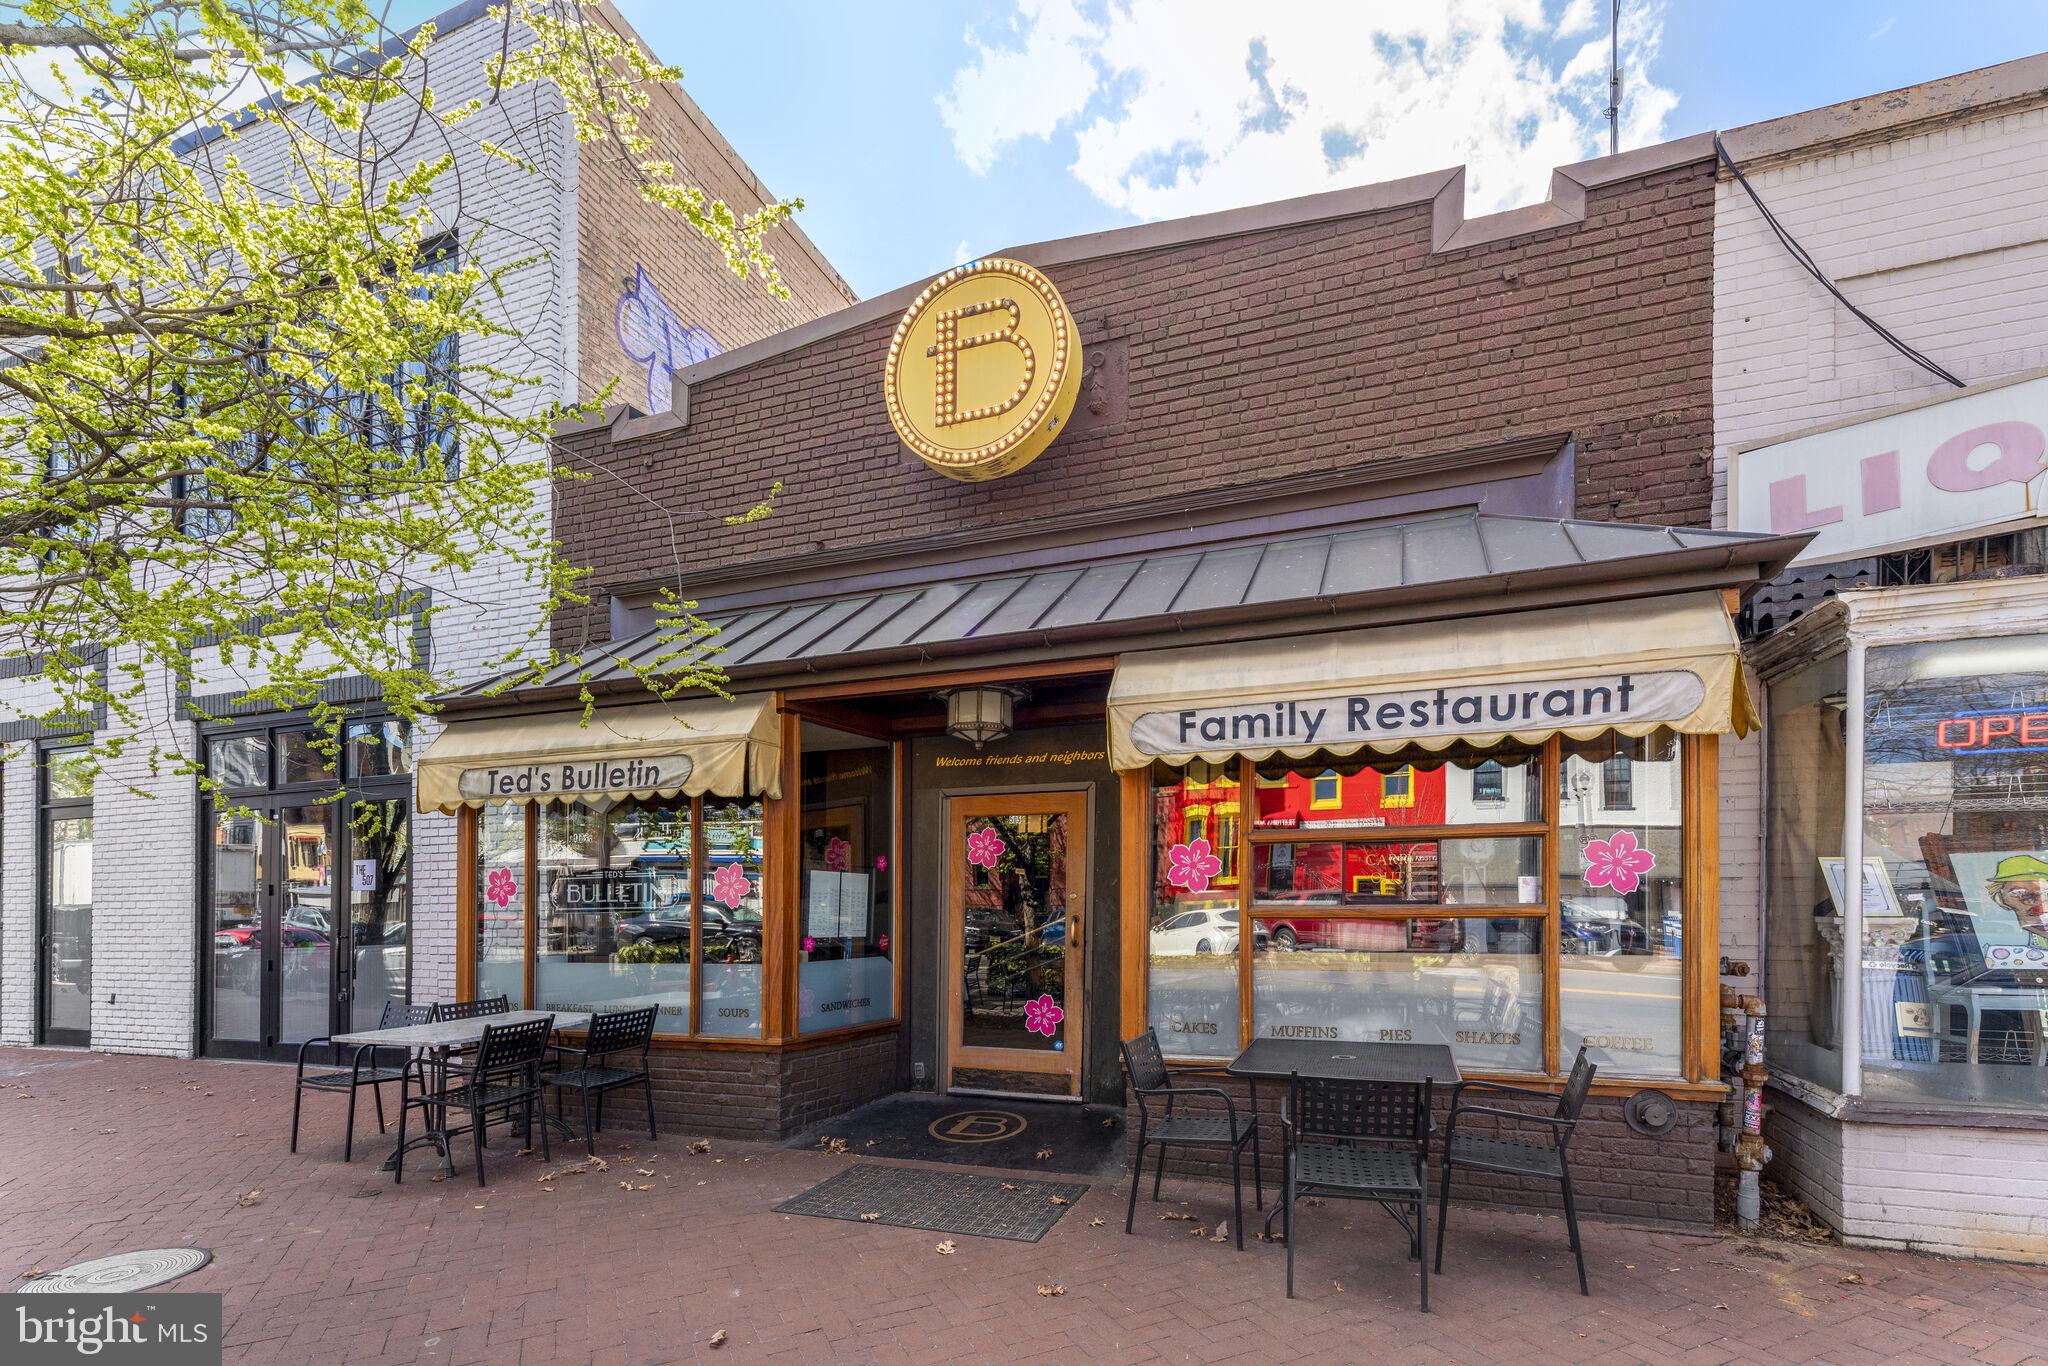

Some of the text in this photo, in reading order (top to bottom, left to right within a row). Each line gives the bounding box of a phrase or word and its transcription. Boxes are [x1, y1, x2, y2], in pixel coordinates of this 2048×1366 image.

[1178, 675, 1635, 743] Family Restaurant
[1937, 715, 2048, 748] OPE
[936, 750, 1105, 767] Welcome friends and neighbors
[487, 759, 660, 794] Ted's Bulletin
[355, 865, 366, 875] THE
[362, 875, 374, 885] 507
[567, 883, 668, 903] BULLETIN
[546, 1004, 593, 1013] BREAKFAST
[718, 1008, 749, 1018] SOUPS
[821, 998, 871, 1012] SANDWICHES
[1172, 1022, 1218, 1034] CAKES
[1271, 1025, 1521, 1046] MUFFINS PIES SHAKES
[1583, 1035, 1654, 1051] COFFEE
